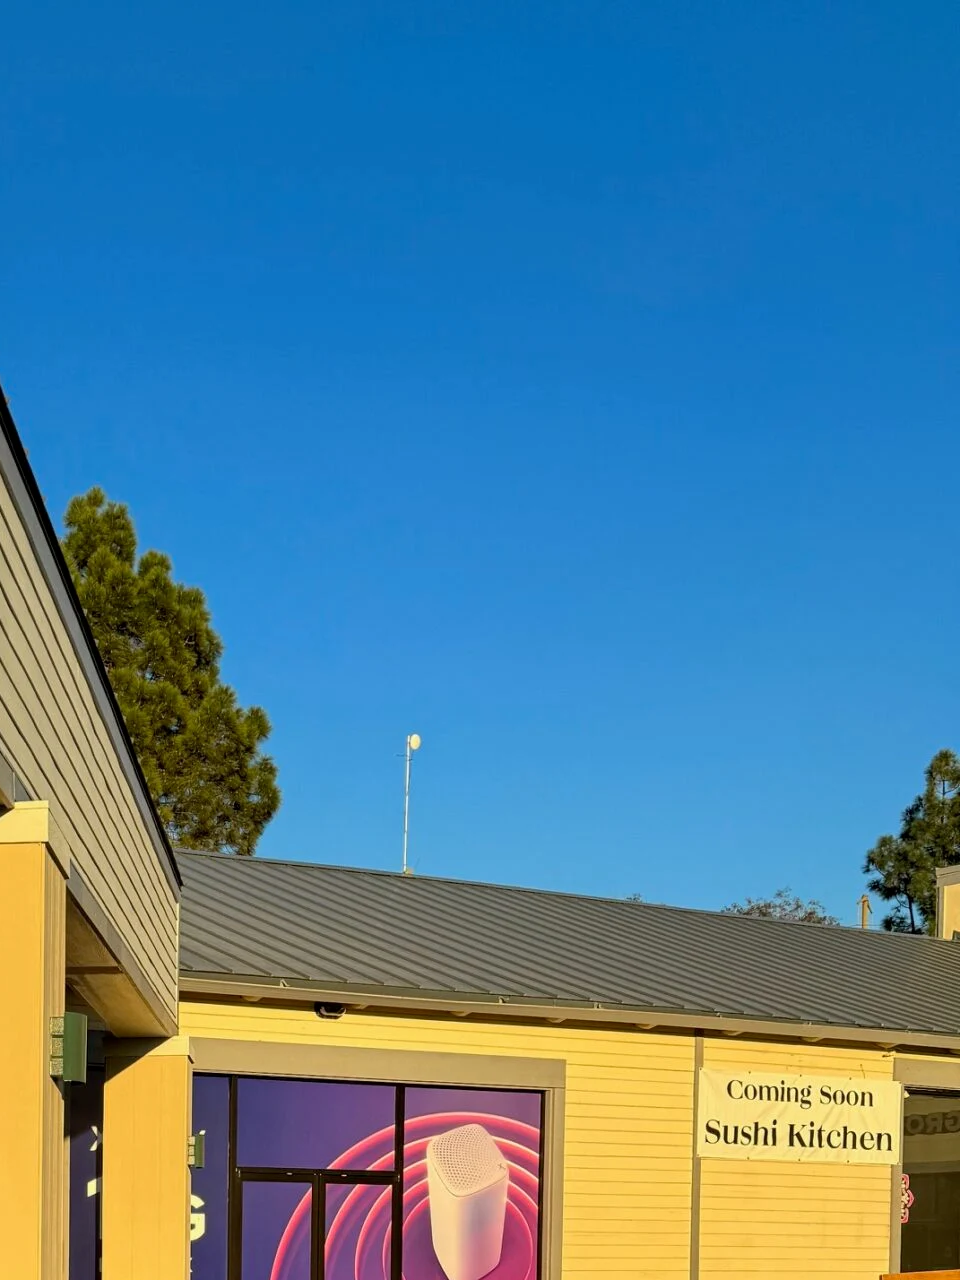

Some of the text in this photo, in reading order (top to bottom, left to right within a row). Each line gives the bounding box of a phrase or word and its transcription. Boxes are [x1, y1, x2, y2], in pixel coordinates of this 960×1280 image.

[727, 1079, 874, 1110] Coming Soon
[704, 1119, 893, 1151] Sushi Kitchen
